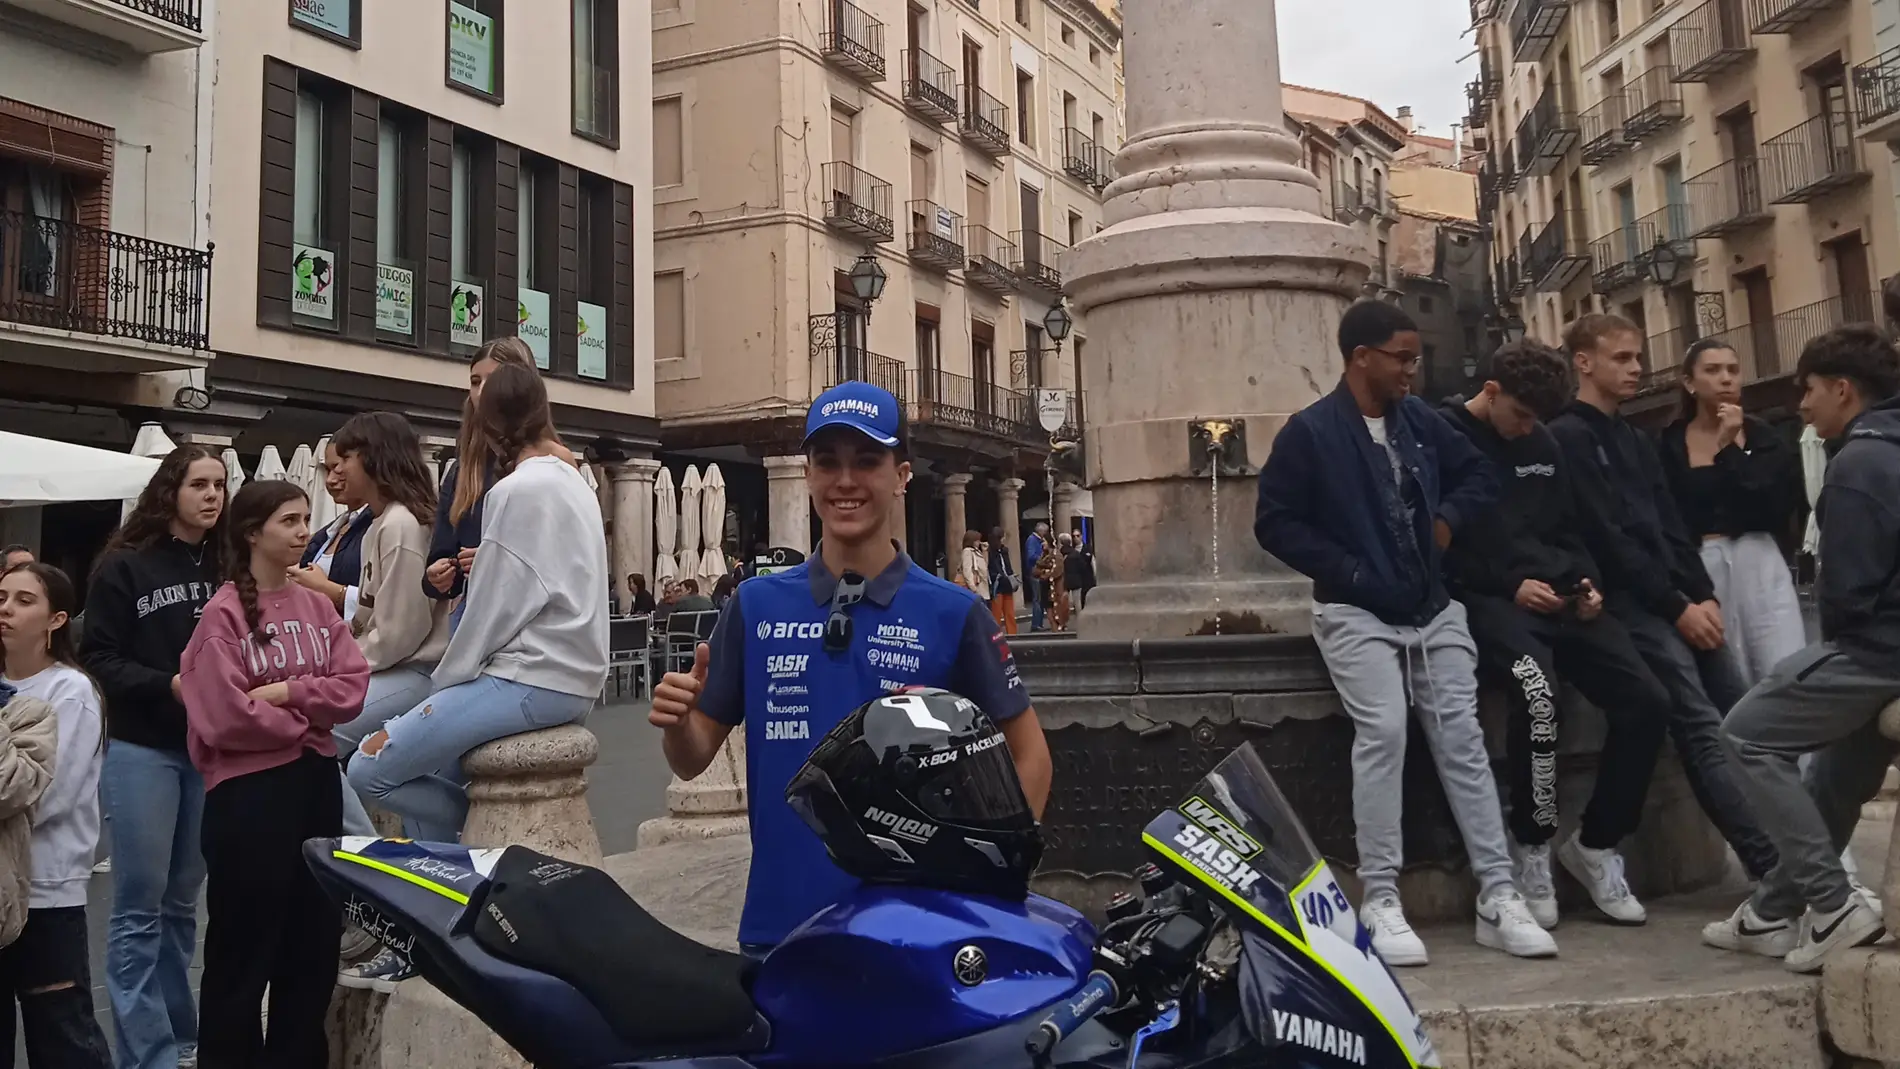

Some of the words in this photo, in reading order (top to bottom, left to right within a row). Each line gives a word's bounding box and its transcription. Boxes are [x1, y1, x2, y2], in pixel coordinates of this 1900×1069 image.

[378, 266, 411, 285] UEGOS
[376, 283, 411, 305] ÓMICS
[520, 323, 548, 338] SADDAC
[580, 335, 605, 350] SADDAC
[833, 399, 879, 416] YAMAHA
[137, 581, 201, 618] SAINT
[773, 621, 824, 639] arco
[877, 623, 919, 639] MOTOR
[867, 634, 905, 648] University
[905, 640, 925, 652] Team
[766, 654, 809, 673] SASH
[880, 650, 920, 670] YAMAHA
[772, 704, 810, 715] musepan
[765, 720, 810, 740] SAICA
[863, 805, 939, 839] NOLAN
[1183, 799, 1260, 855] WRS
[1173, 824, 1262, 891] SASH
[1271, 1007, 1366, 1067] YAMAHA
